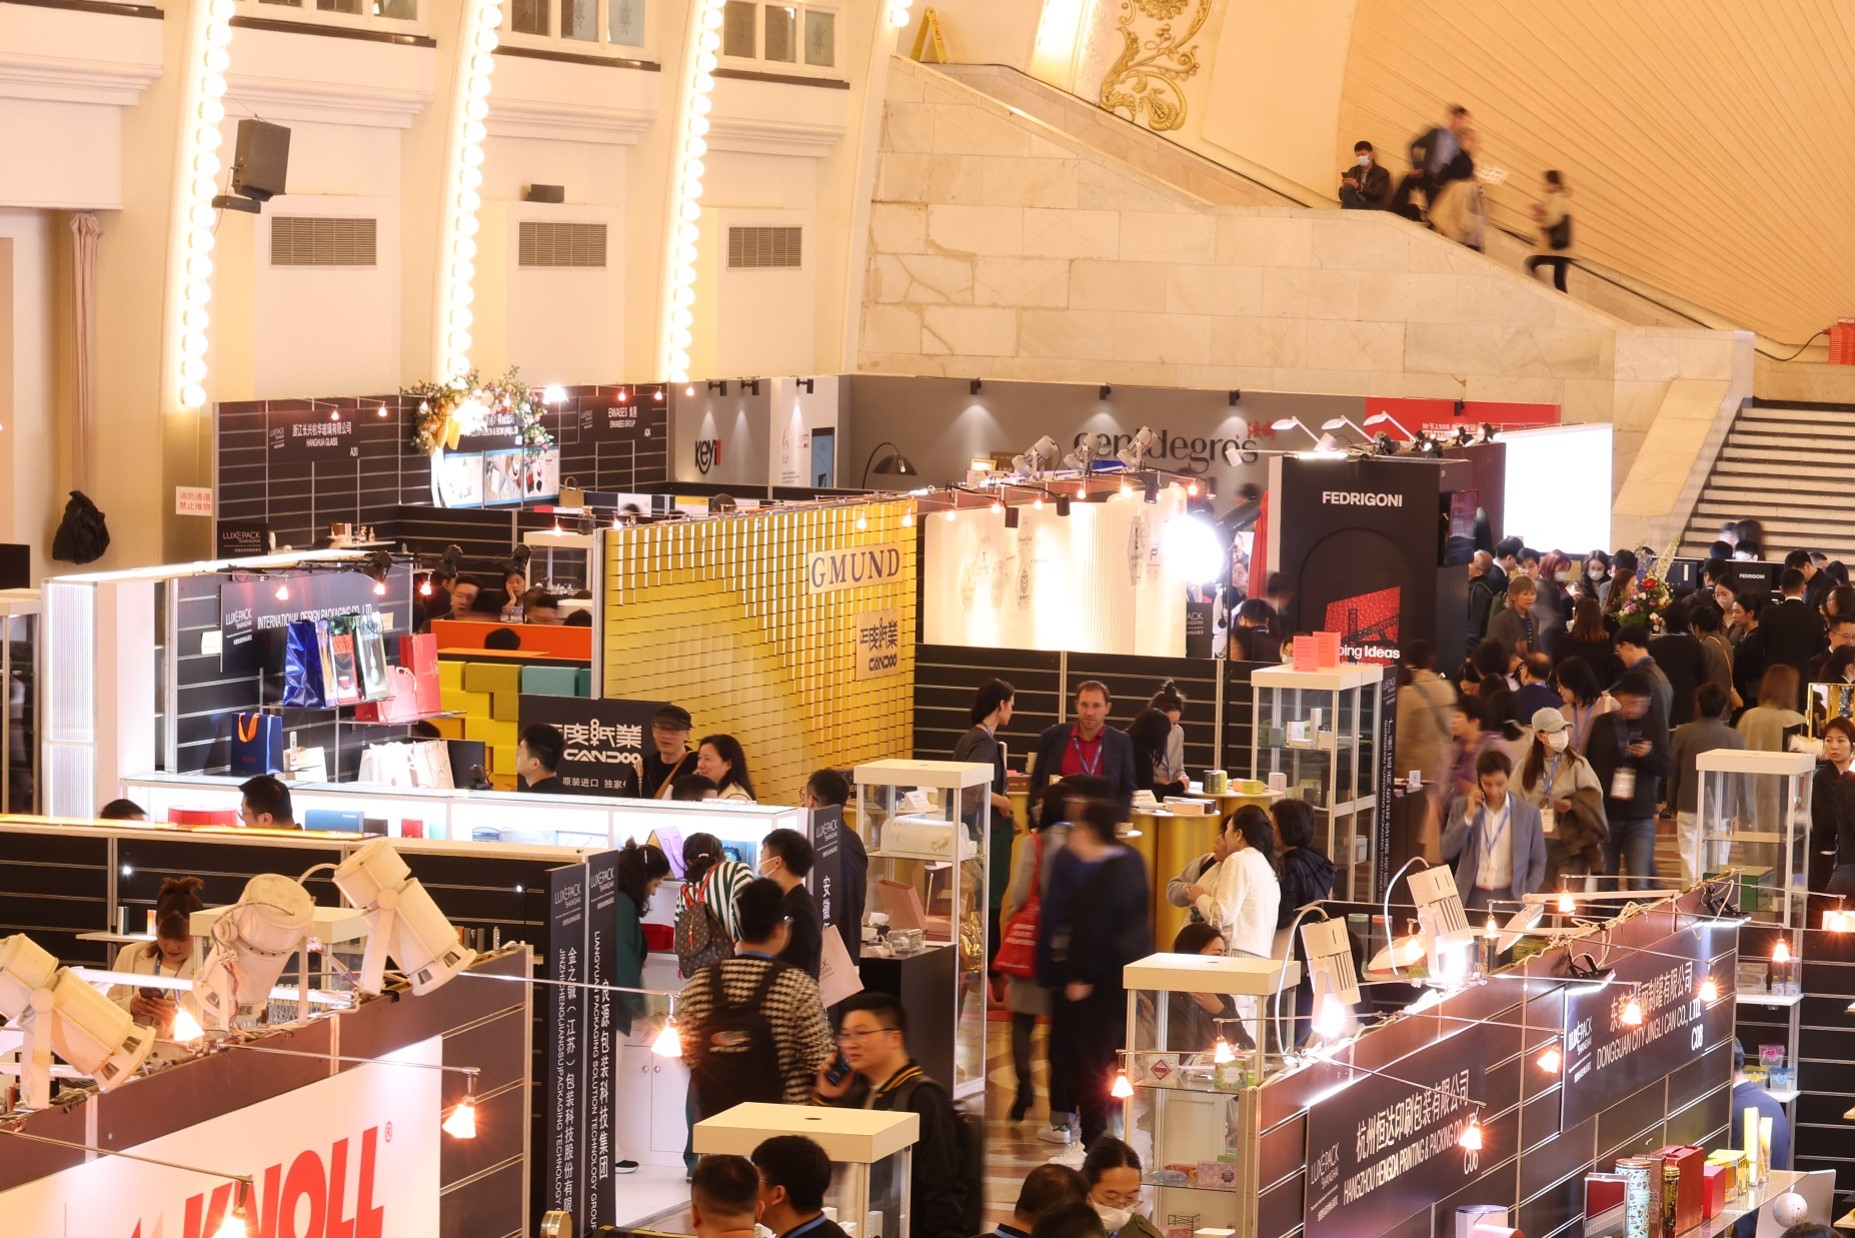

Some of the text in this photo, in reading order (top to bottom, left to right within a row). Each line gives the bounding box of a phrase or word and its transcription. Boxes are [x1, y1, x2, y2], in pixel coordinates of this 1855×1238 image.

[326, 438, 339, 447] GLASS
[1322, 490, 1403, 508] FEDRIGONI
[811, 548, 900, 588] GMUND
[257, 612, 300, 630] INTERNATIONAL
[1364, 645, 1400, 659] Ideas
[562, 776, 599, 788] 原装进口
[592, 995, 600, 1058] PACKAGING
[1596, 1032, 1632, 1071] DONGGUAN
[1632, 1026, 1646, 1052] CITY
[1646, 1014, 1664, 1045] JINGLI
[1664, 1008, 1677, 1034] CAN
[1691, 1024, 1704, 1051] C08
[1356, 1068, 1470, 1163] 杭州恒达印刷包装有限公司
[554, 1132, 564, 1205] TECHNOLOGY
[590, 1116, 599, 1190] TECHNOLOGY
[1311, 1142, 1340, 1185] LUXEPACK
[1343, 1164, 1376, 1206] HANGZHOU
[1375, 1154, 1400, 1188] HENGDA
[1399, 1138, 1425, 1175] PRINTING
[1424, 1135, 1430, 1161] &
[1429, 1125, 1454, 1159] PACKING
